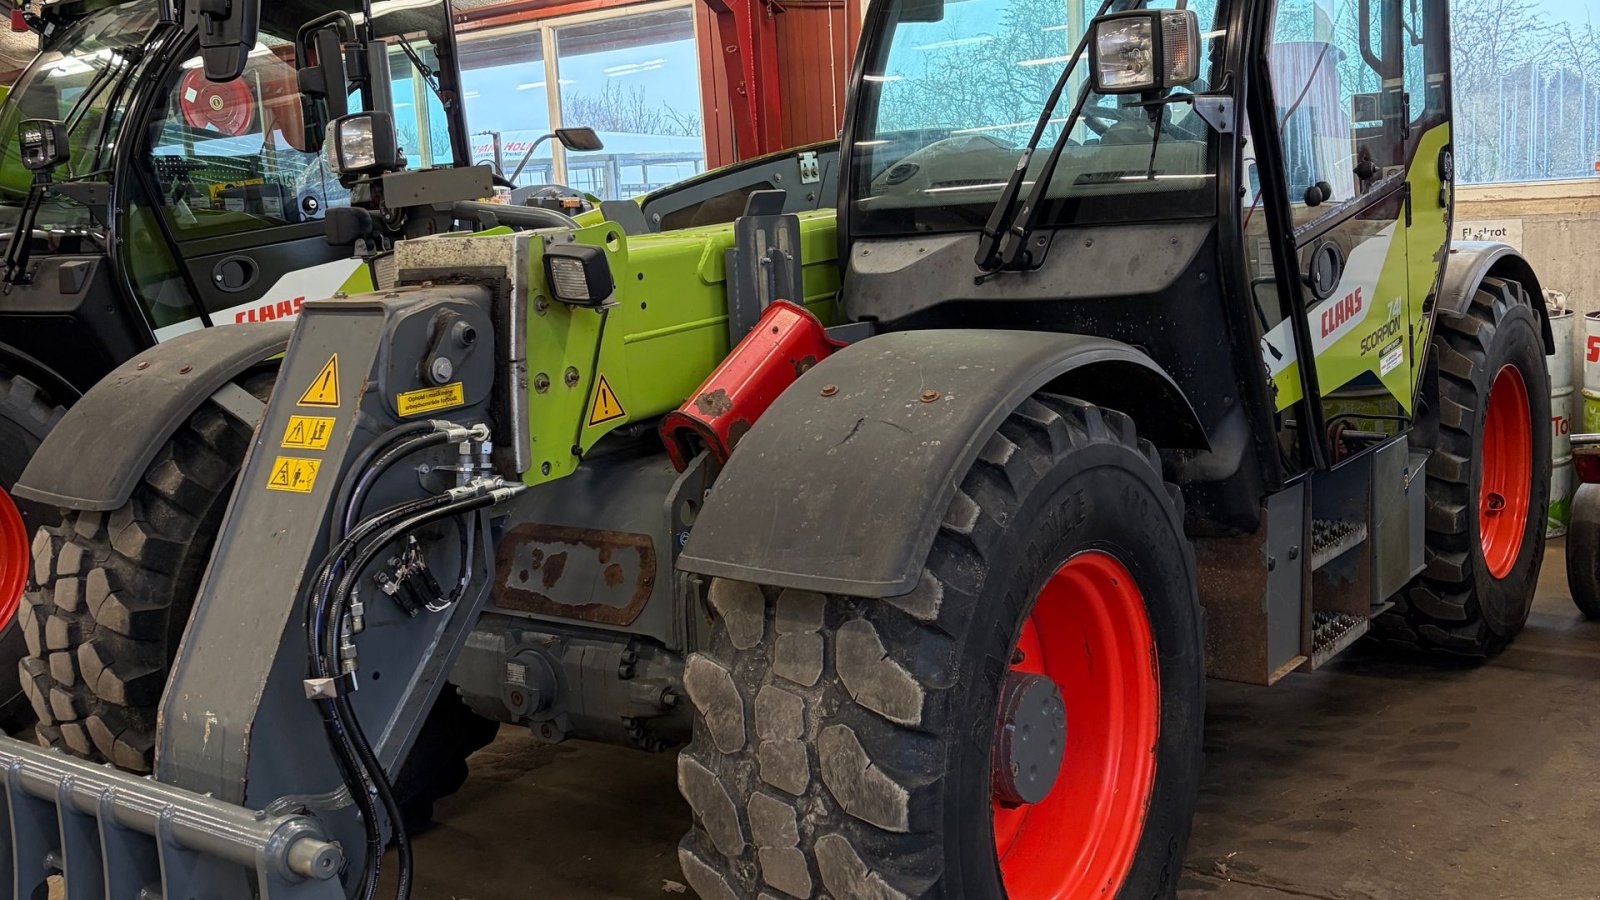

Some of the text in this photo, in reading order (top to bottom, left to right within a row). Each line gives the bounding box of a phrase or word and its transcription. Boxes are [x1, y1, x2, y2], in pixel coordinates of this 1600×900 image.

[235, 296, 305, 324] CLAAS
[1321, 286, 1362, 339] CLAAS
[1360, 315, 1401, 356] SCORPION
